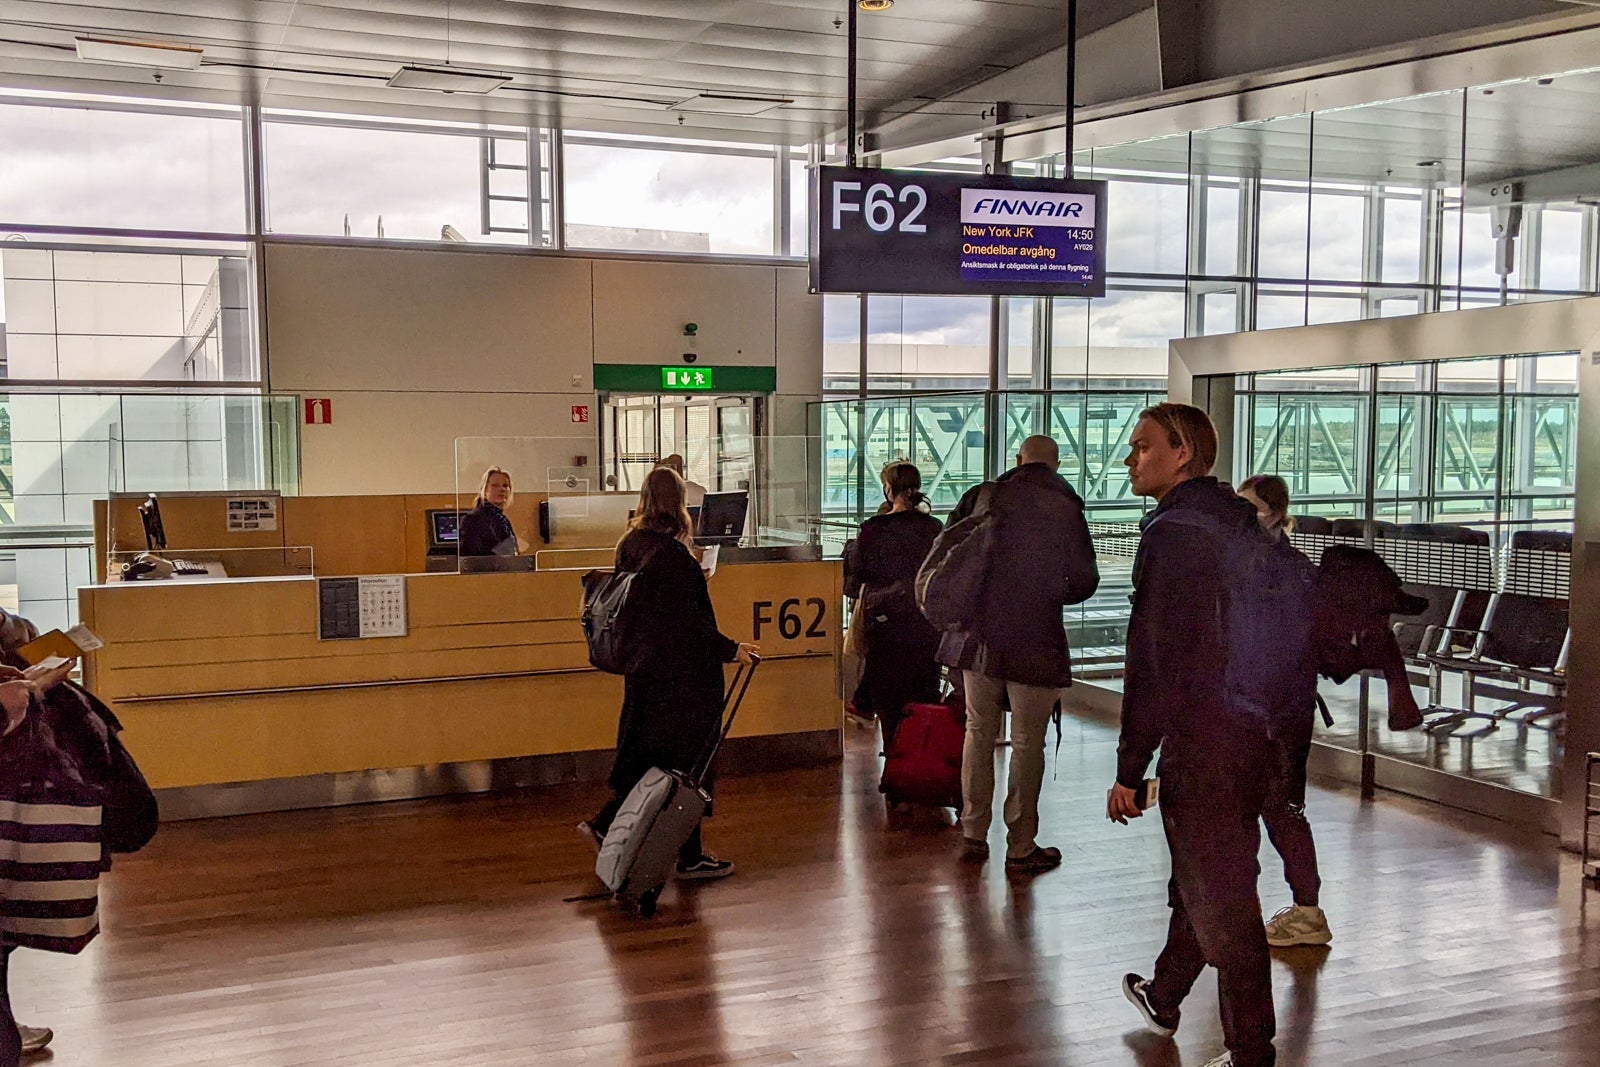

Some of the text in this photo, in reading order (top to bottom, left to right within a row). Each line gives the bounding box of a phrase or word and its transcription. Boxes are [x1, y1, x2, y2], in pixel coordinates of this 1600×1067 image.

[832, 181, 928, 233] F62
[973, 198, 1083, 218] FINNAIR
[963, 225, 1034, 238] New York JFK
[1067, 229, 1093, 240] 14:50
[962, 243, 1056, 259] Omedelbar avgång
[961, 261, 998, 269] Ansiktsmask
[1006, 262, 1039, 271] obligatorisk
[1040, 263, 1048, 272] på
[1067, 264, 1089, 273] flygning
[753, 597, 827, 641] F62
